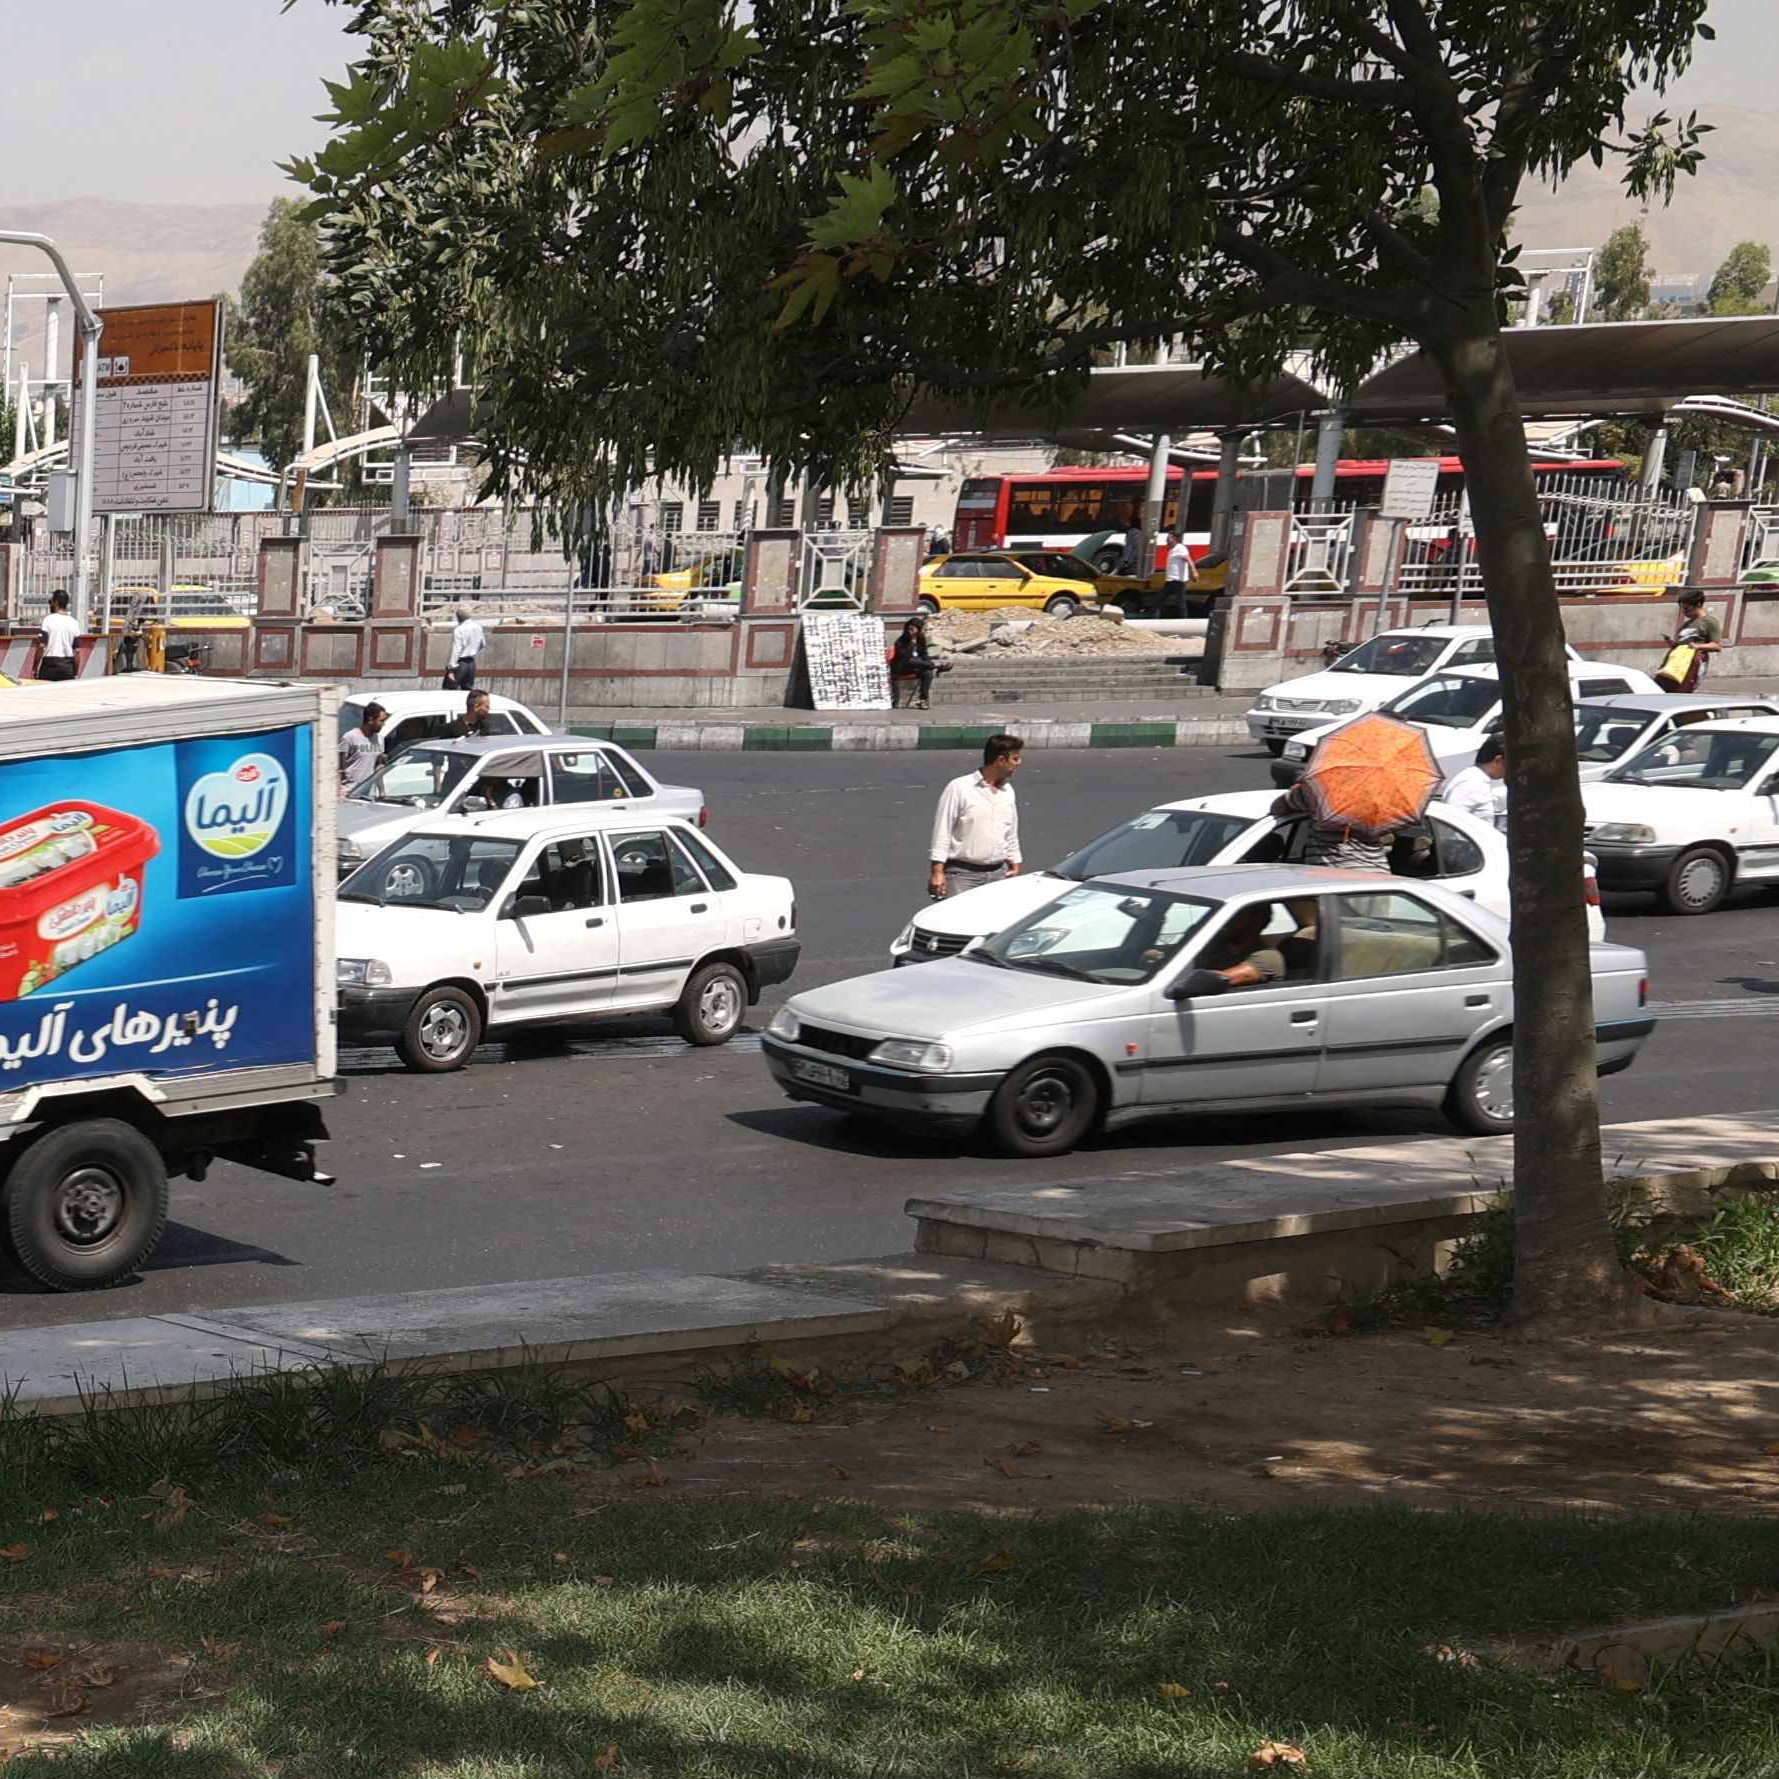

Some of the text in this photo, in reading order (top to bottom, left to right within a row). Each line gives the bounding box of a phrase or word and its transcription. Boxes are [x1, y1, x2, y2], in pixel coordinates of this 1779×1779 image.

[136, 387, 158, 395] مقصد
[196, 777, 281, 834] آلیما
[69, 998, 239, 1063] پنیرهای
